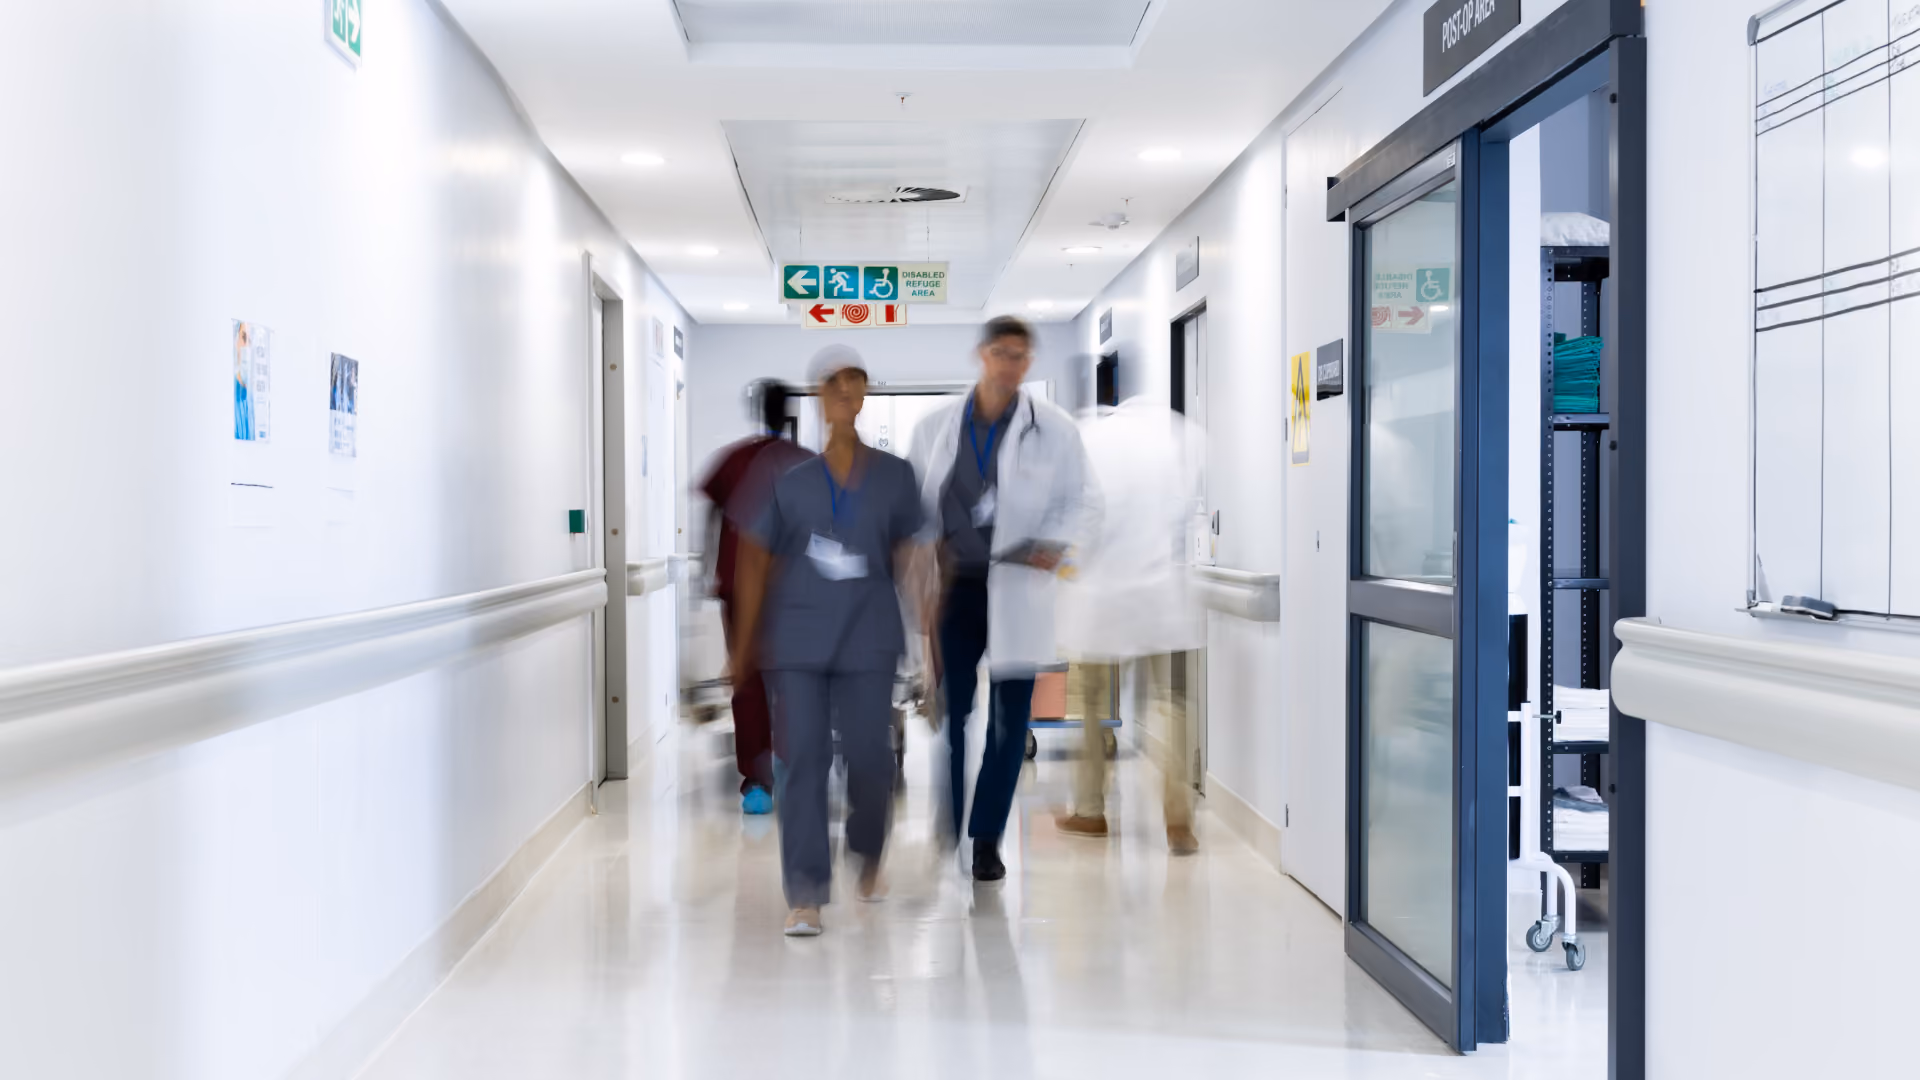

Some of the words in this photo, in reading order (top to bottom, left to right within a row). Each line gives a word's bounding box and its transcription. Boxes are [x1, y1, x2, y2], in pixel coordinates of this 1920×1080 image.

[1442, 0, 1474, 53] POST-OP
[902, 271, 945, 279] DISABLED
[906, 280, 941, 288] REFUGE
[911, 289, 936, 297] AREA
